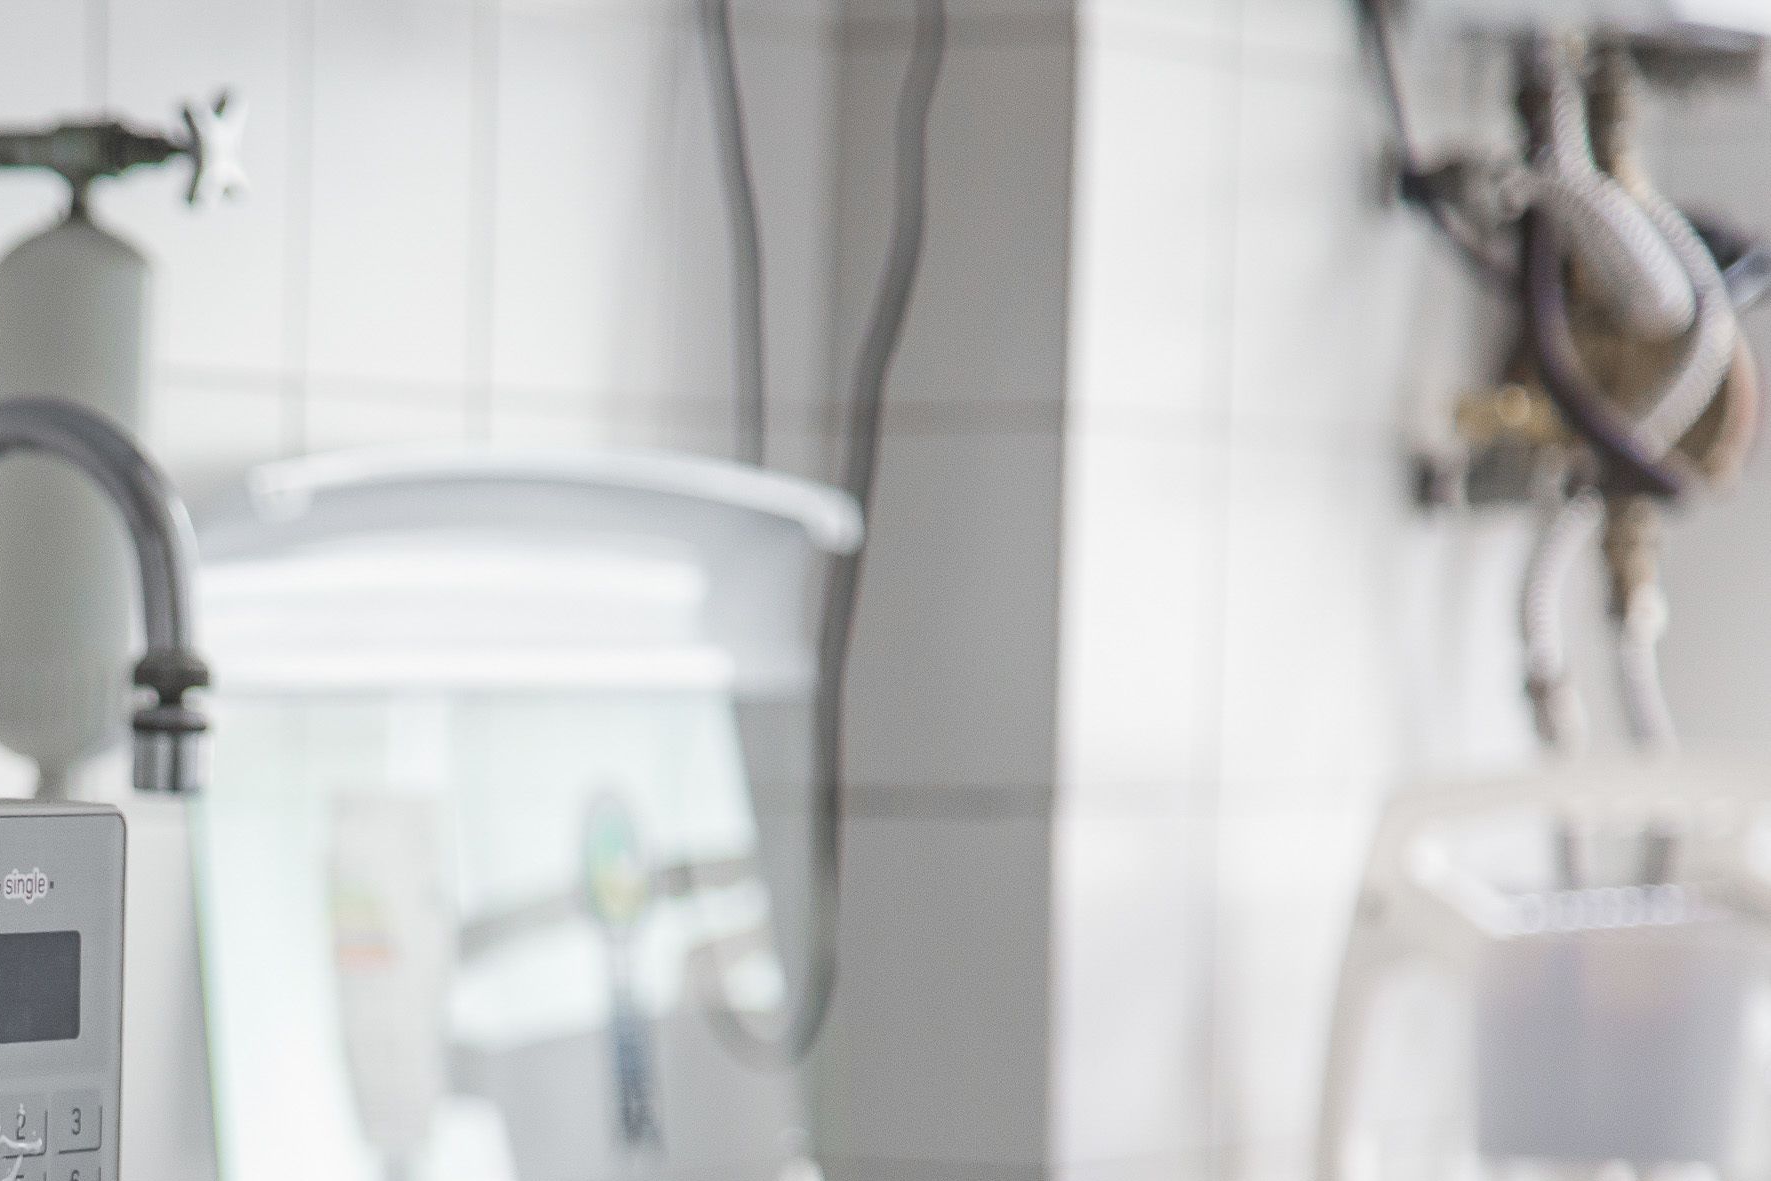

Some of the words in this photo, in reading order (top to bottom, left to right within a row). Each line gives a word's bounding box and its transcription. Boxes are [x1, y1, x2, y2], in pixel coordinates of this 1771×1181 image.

[5, 872, 46, 899] single
[16, 1113, 26, 1140] 2
[71, 1107, 82, 1136] 3
